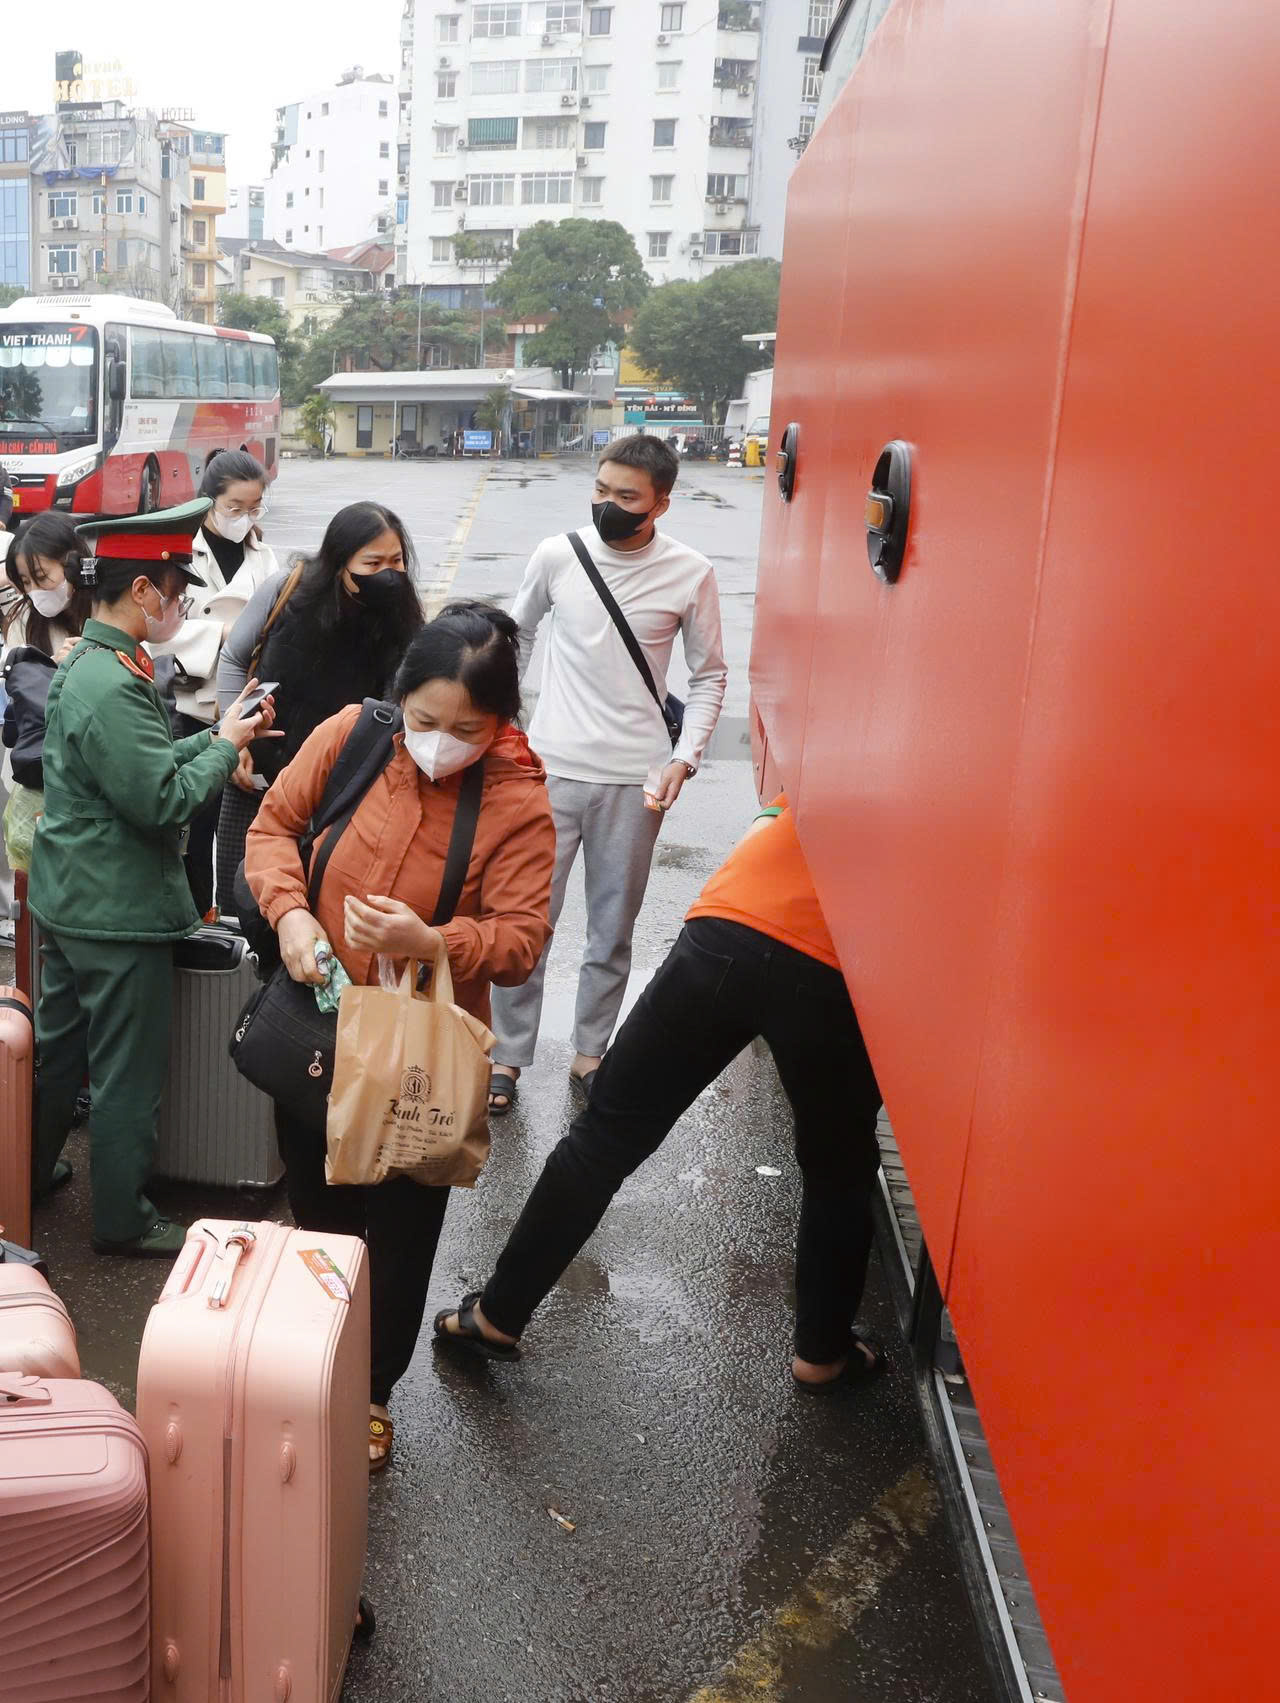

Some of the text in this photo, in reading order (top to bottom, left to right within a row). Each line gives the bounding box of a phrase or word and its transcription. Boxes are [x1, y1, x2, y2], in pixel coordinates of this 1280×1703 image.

[161, 107, 195, 121] HOTEL
[3, 334, 28, 347] VIET
[31, 333, 72, 345] THANH
